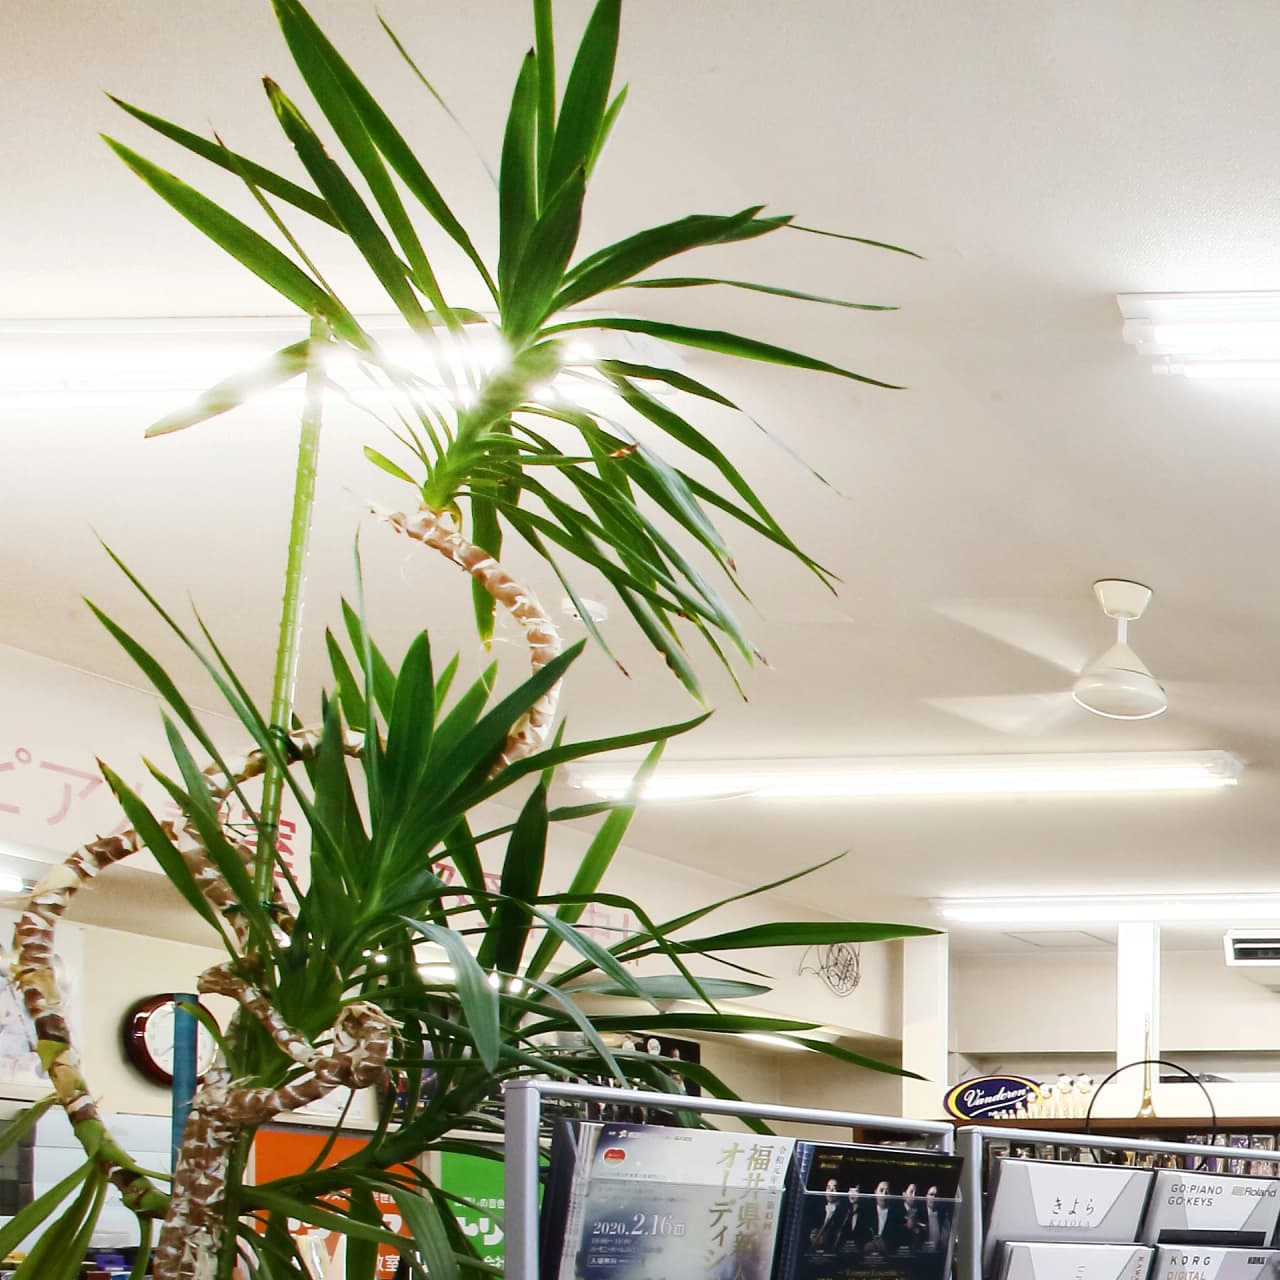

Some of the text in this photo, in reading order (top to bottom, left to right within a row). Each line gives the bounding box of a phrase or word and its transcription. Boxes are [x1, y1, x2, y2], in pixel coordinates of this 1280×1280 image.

[963, 1086, 1028, 1108] Vandoren
[1170, 1183, 1223, 1196] GO:PIANO
[1244, 1187, 1277, 1198] Roland
[1052, 1196, 1095, 1216] きよら
[593, 1213, 672, 1236] 2020.2.16
[1170, 1256, 1212, 1266] KORG
[1167, 1270, 1206, 1280] DIGITAL
